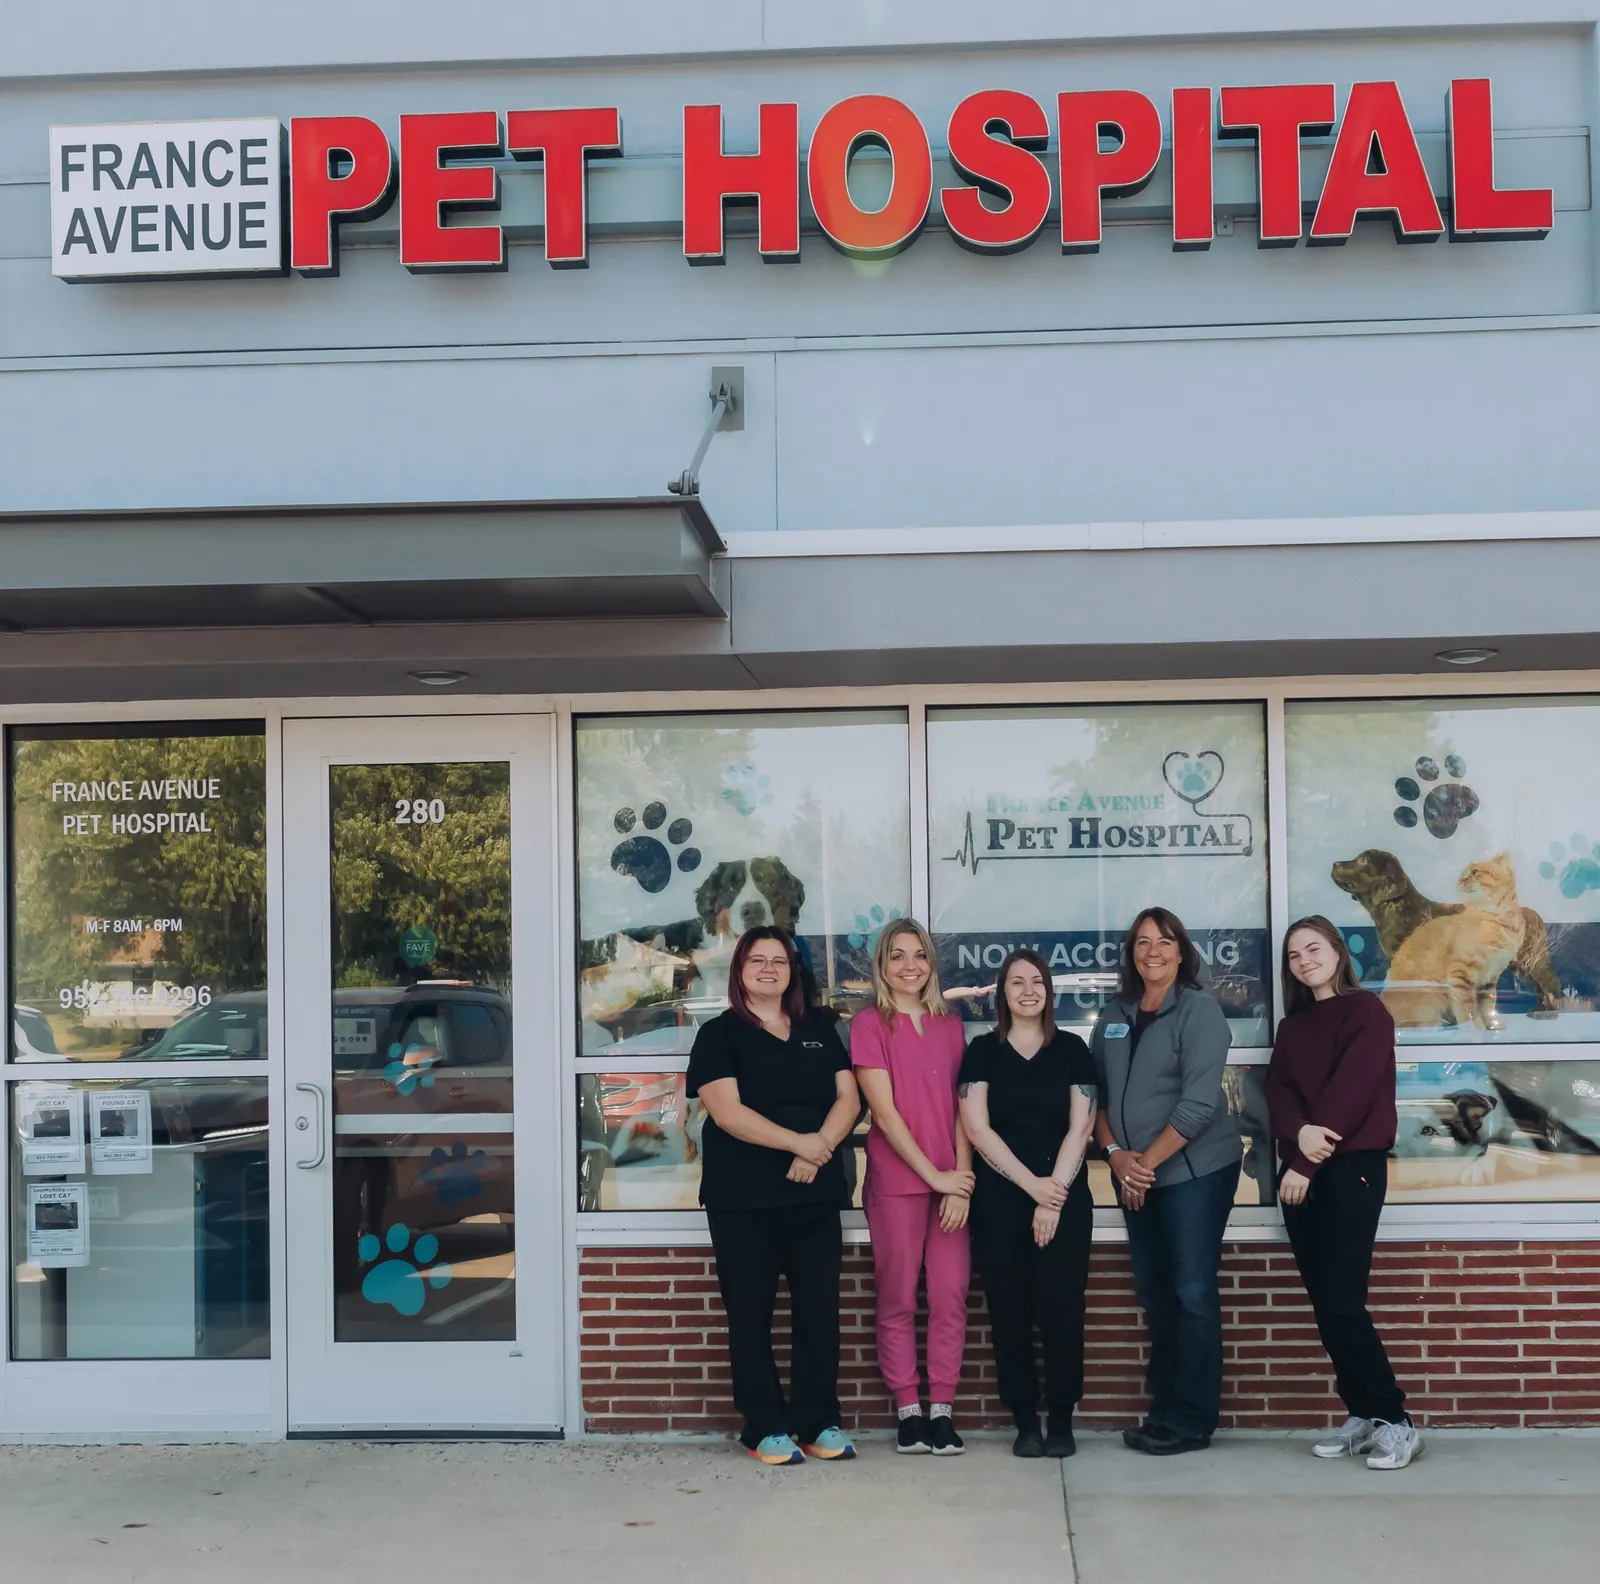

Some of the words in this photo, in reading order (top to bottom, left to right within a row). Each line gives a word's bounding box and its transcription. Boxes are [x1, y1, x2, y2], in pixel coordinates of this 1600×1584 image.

[60, 138, 269, 192] FRANCE
[290, 107, 622, 270] PET
[682, 78, 1554, 258] HOSPITAL
[60, 201, 269, 256] AVENUE
[51, 780, 134, 802] FRANCE
[138, 778, 221, 801] AVENUE
[1076, 790, 1165, 812] AVENUE
[63, 814, 102, 835] PET
[112, 812, 212, 834] HOSPITAL
[394, 798, 445, 824] 280
[986, 818, 1058, 850] PET
[1068, 816, 1243, 849] HOSPITAL
[86, 919, 111, 933] M-F
[113, 919, 142, 933] 8AM
[153, 918, 183, 932] 6PM
[406, 942, 430, 952] FAVE
[1050, 941, 1241, 968] ACCNG
[59, 985, 212, 1009] 9527460296
